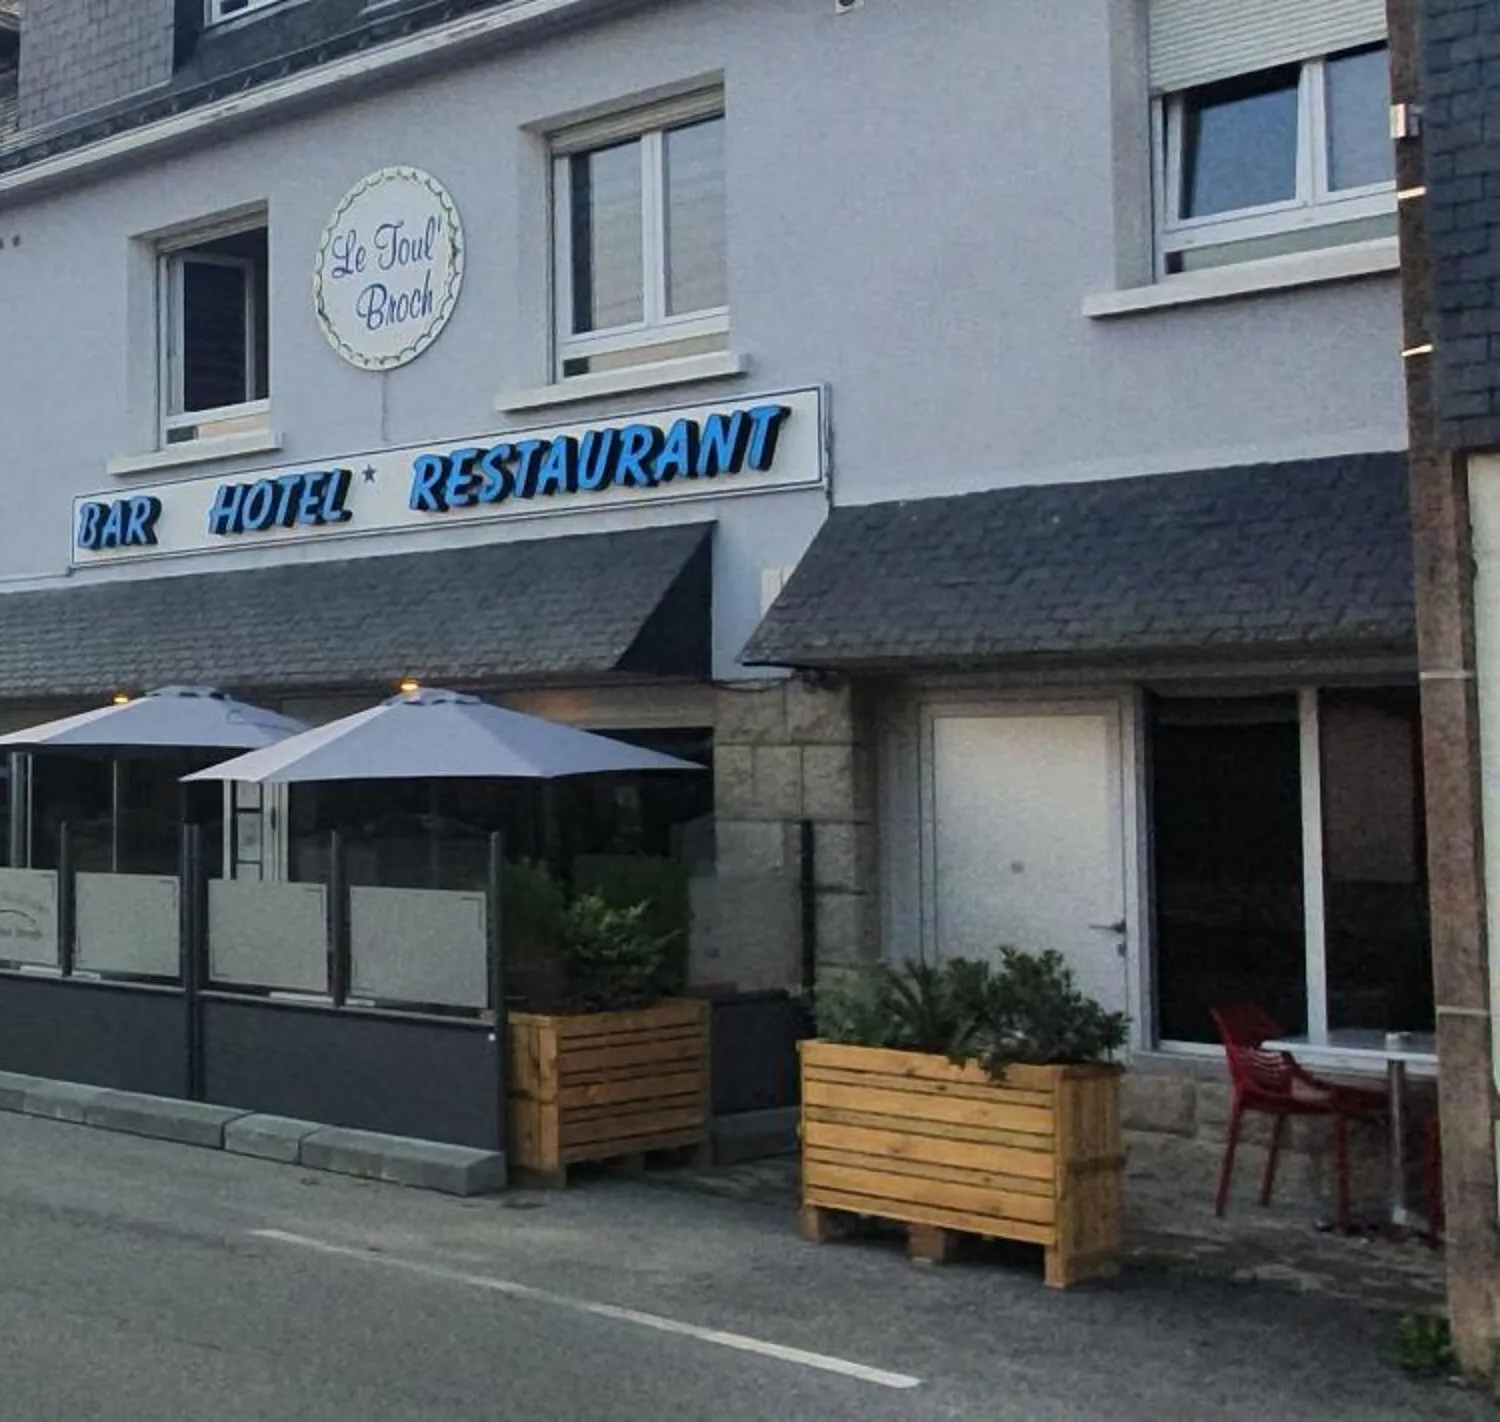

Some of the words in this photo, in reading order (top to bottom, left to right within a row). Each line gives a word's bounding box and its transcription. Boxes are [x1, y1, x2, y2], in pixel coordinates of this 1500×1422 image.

[331, 229, 367, 279] Le
[355, 268, 433, 331] Broch
[77, 495, 163, 549] BAR
[208, 467, 354, 534] HOTEL
[409, 403, 792, 512] RESTAURANT
